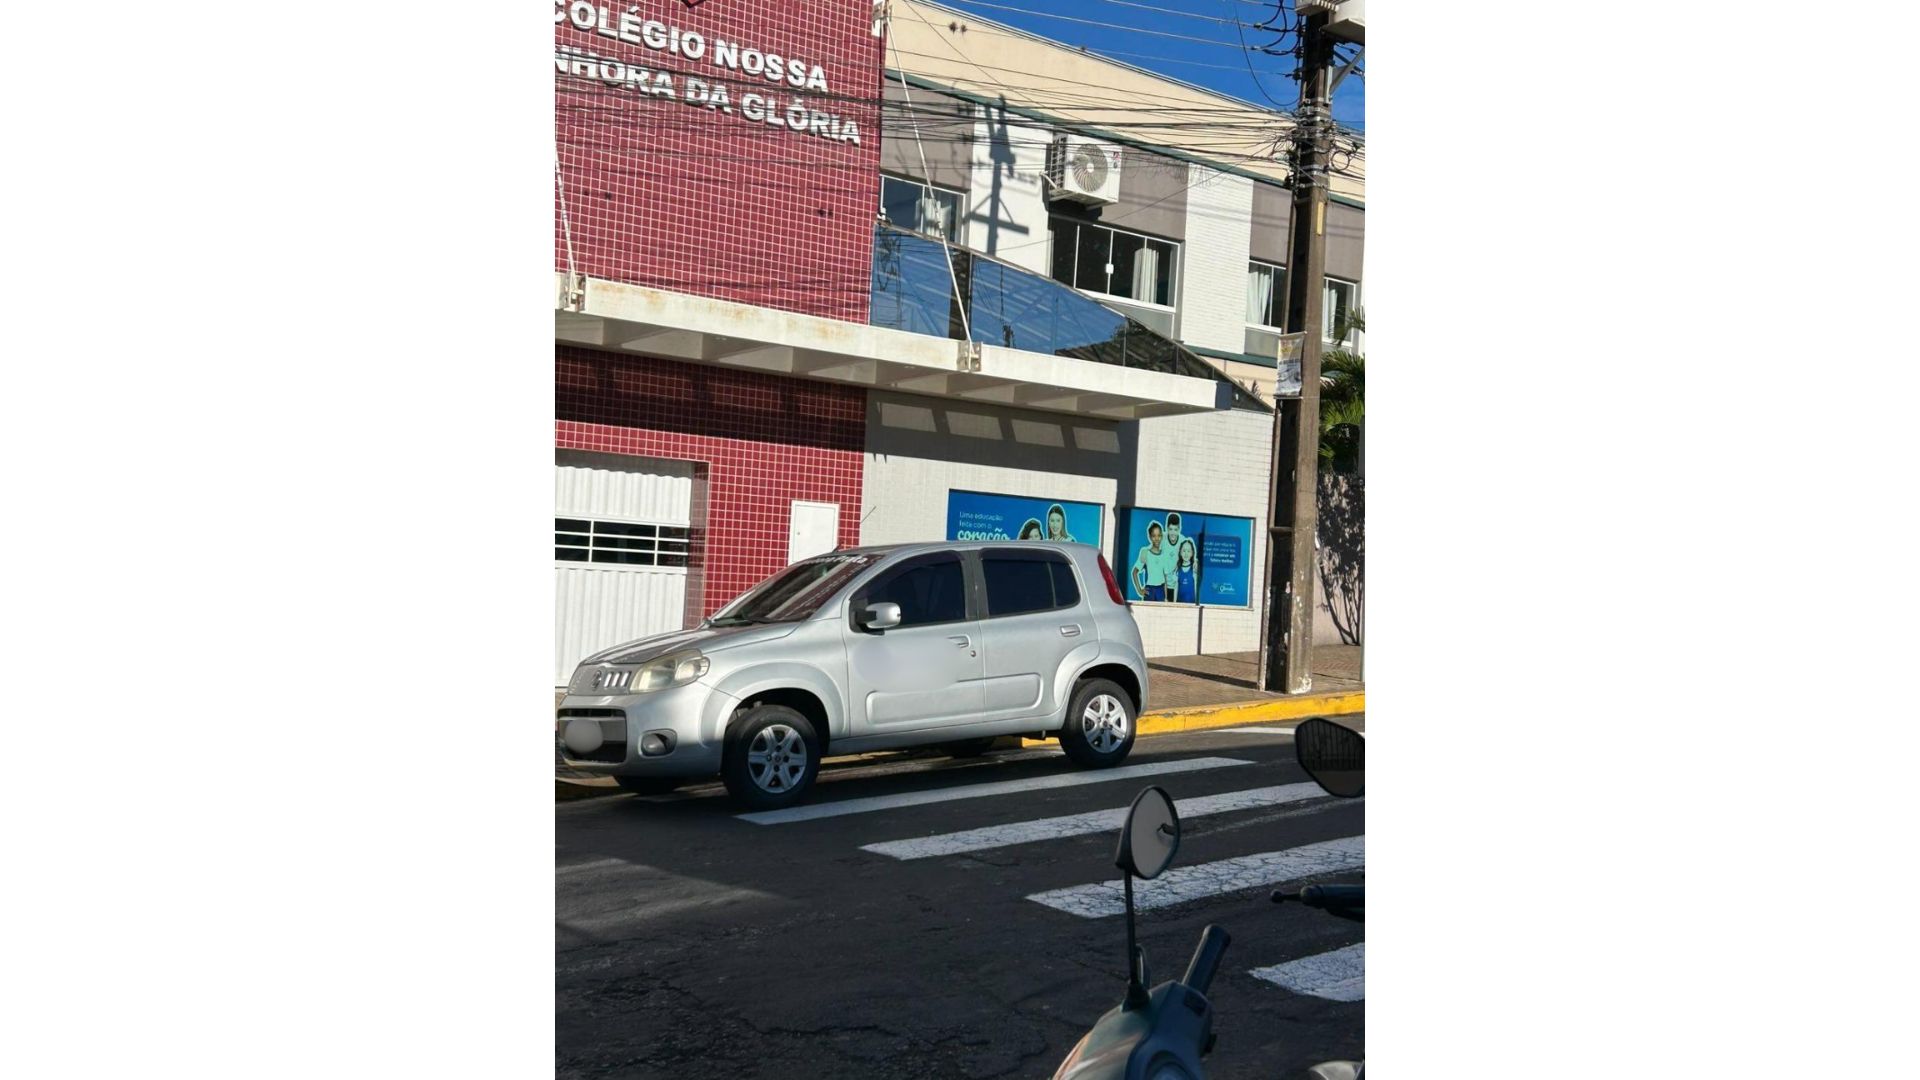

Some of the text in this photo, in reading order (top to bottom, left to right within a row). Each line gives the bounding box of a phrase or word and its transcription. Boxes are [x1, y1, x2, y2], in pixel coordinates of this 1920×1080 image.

[714, 38, 828, 92] NOSSA
[685, 77, 732, 114] DA
[741, 93, 861, 147] GLÓRIA
[959, 511, 974, 519] Uma
[957, 527, 1010, 541] coração
